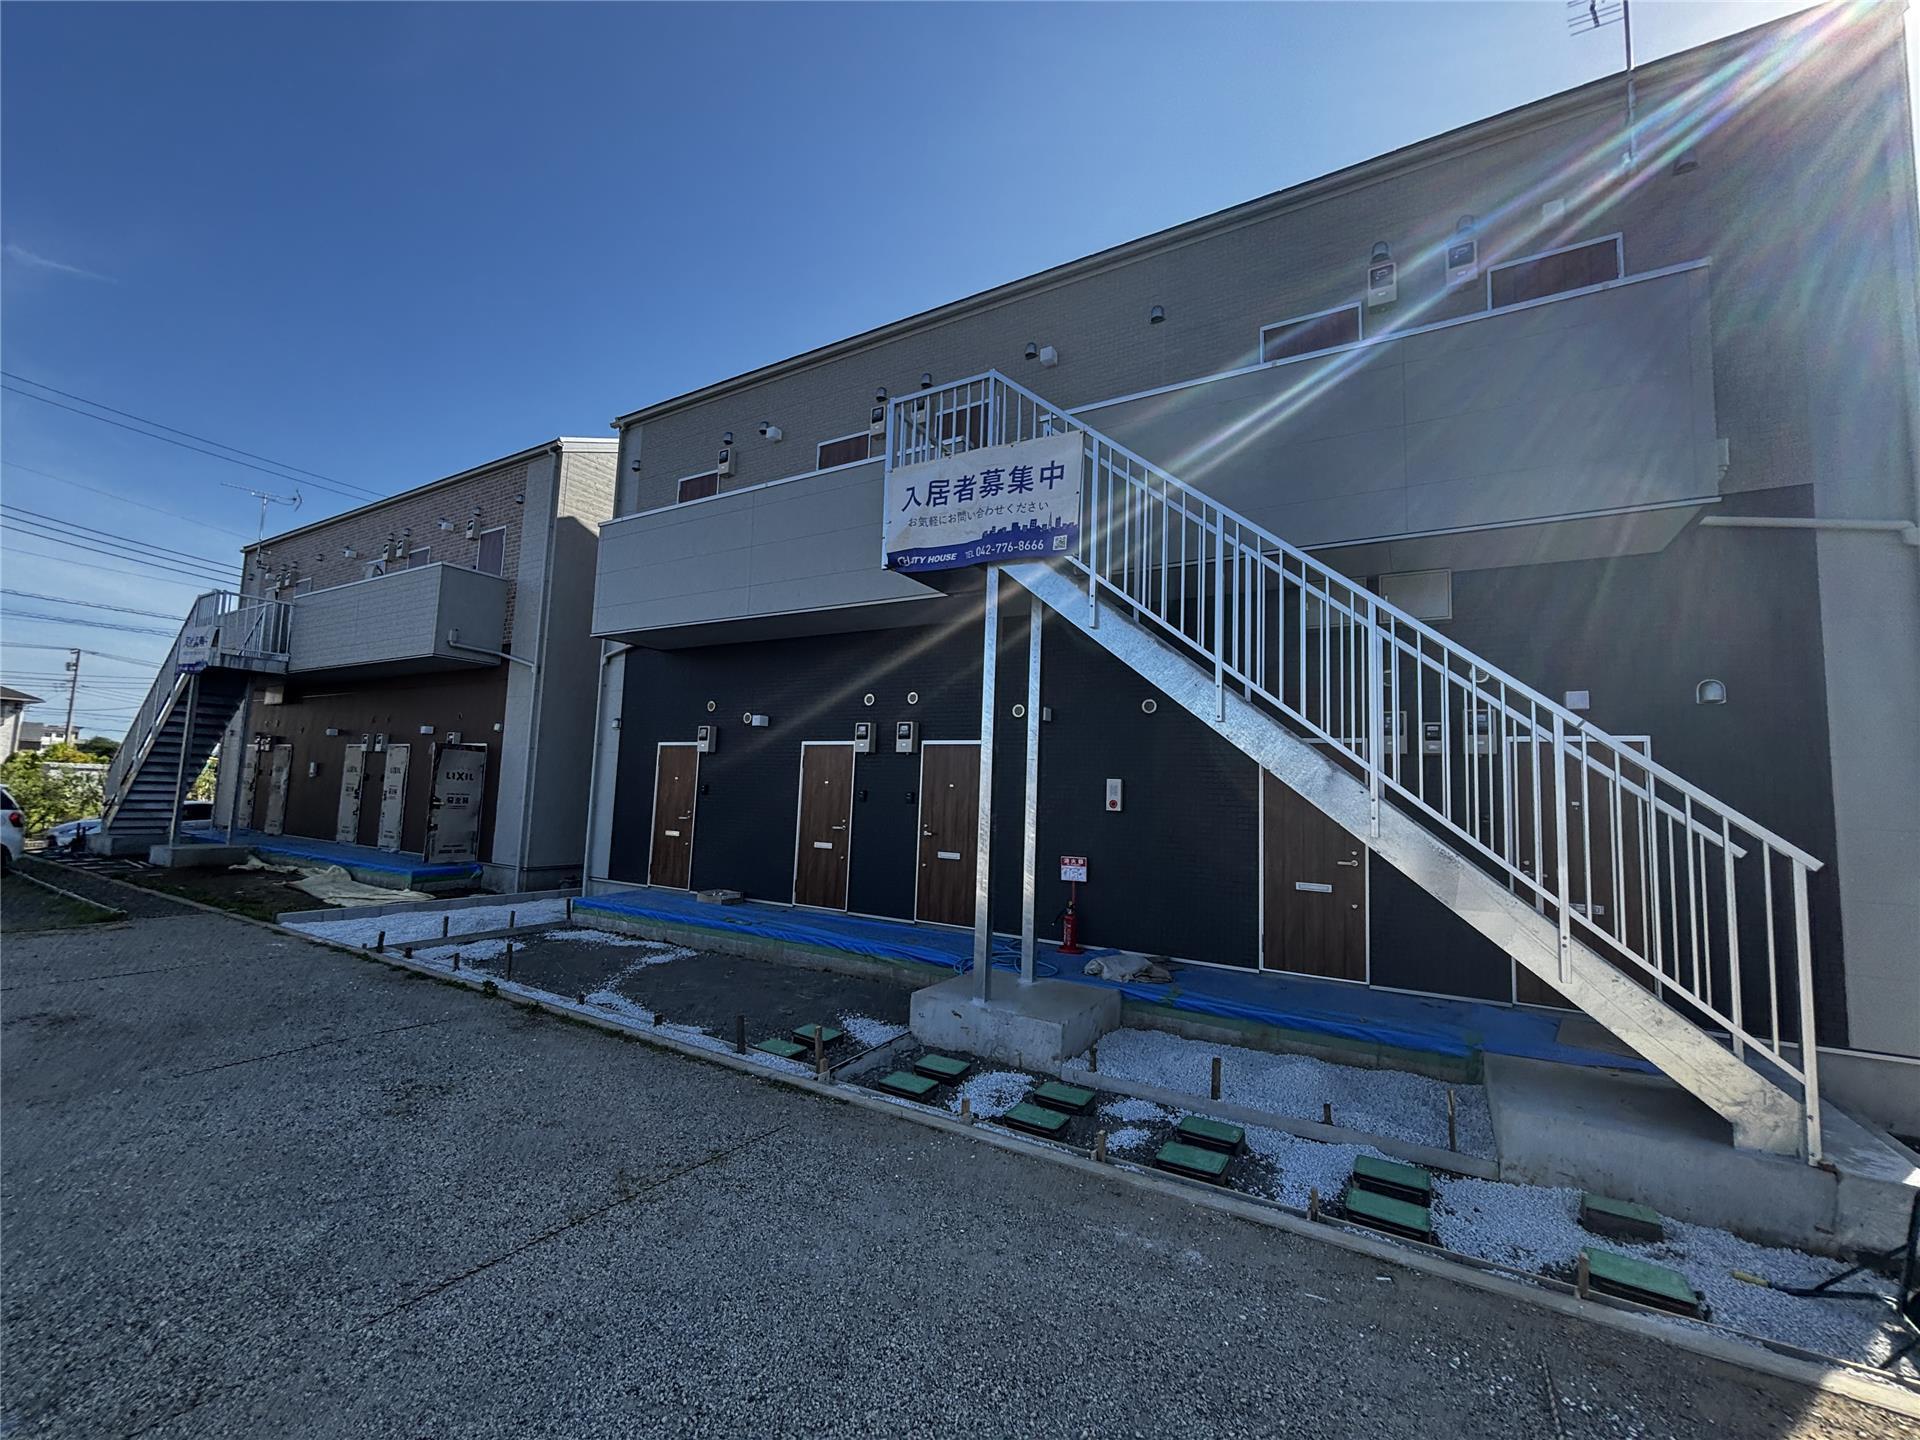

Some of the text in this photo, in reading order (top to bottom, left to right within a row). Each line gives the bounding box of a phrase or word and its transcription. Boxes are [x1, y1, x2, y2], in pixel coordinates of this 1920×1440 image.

[901, 460, 1065, 512] 入居者募集中
[908, 501, 1049, 528] お気軽にお問い合わせください
[927, 552, 958, 564] HOUSE
[965, 539, 1044, 559] TEL 042-776-8666
[446, 771, 474, 781] LIXIL
